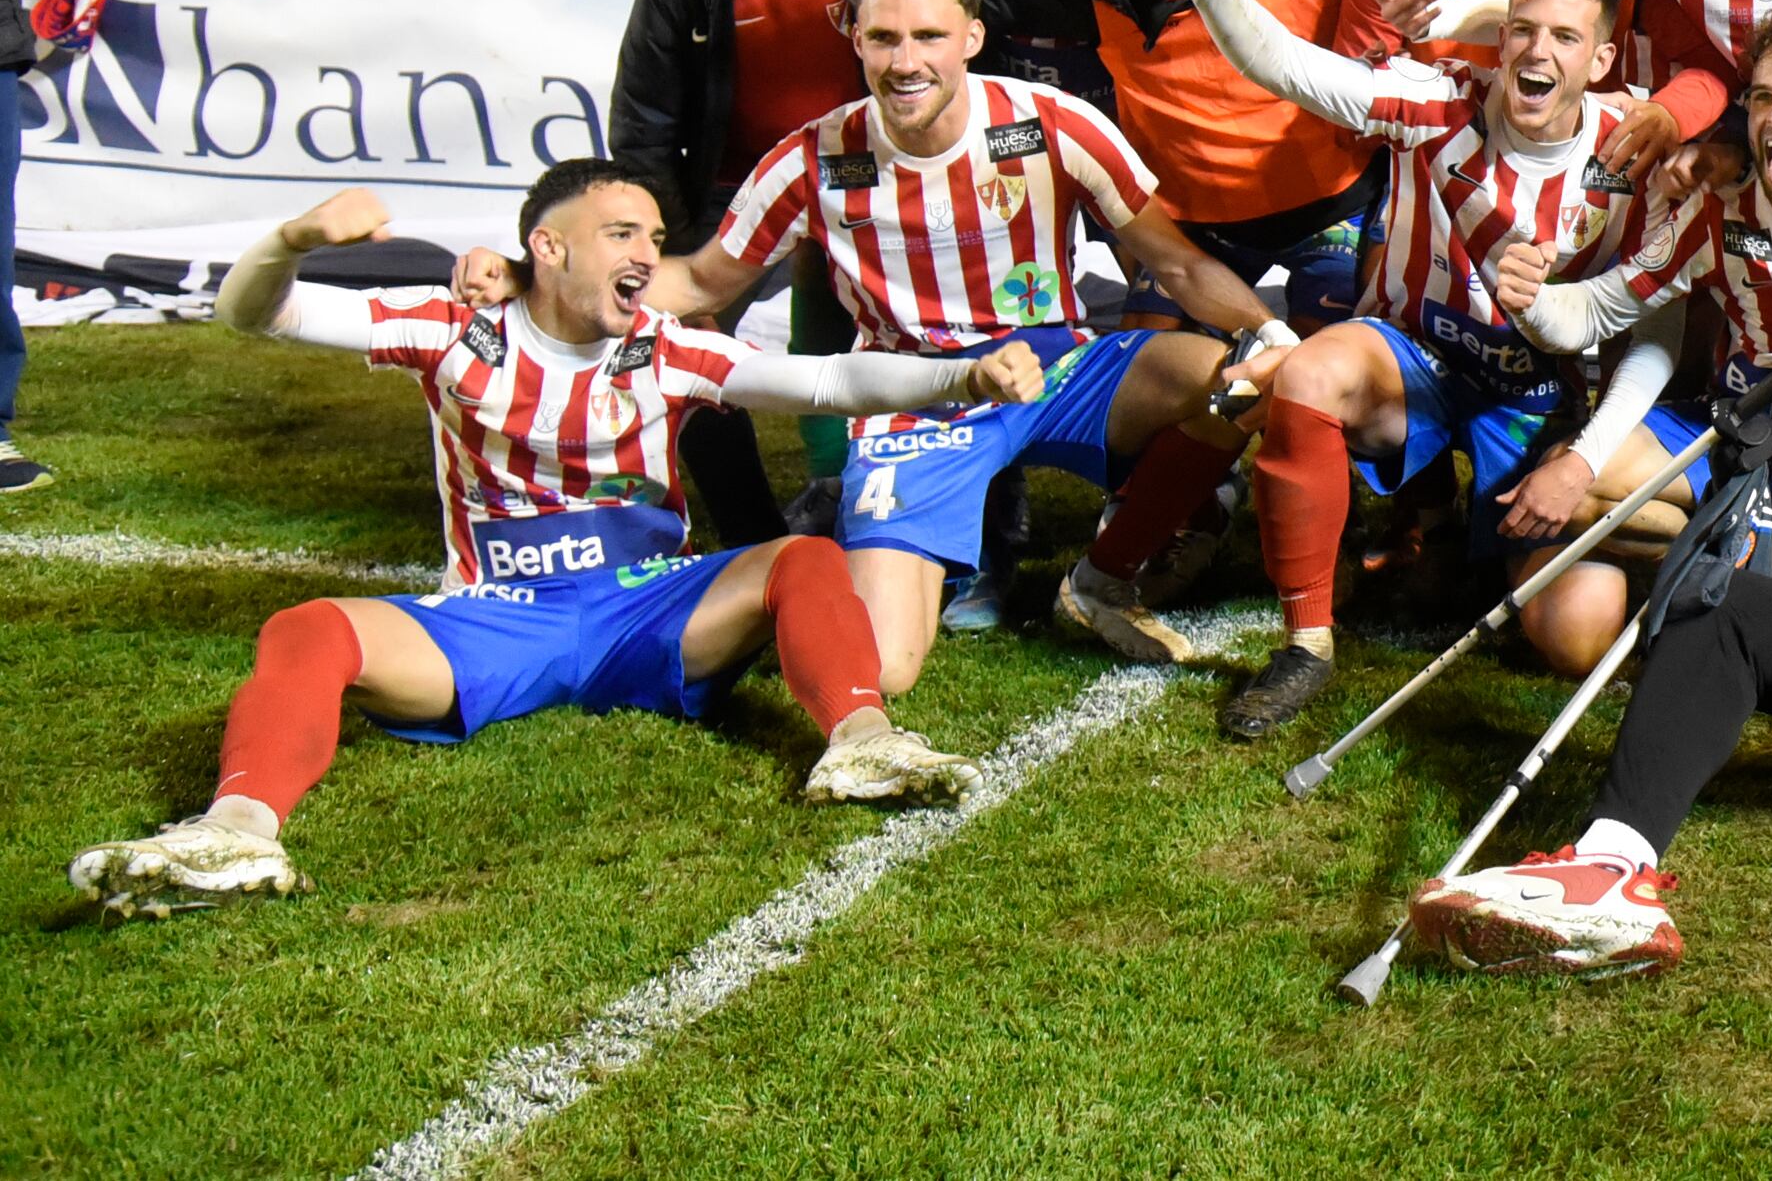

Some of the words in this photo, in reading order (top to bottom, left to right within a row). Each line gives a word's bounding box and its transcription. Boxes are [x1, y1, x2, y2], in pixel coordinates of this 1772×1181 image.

[988, 130, 1043, 151] Huesca
[820, 163, 876, 178] Huesca
[1724, 231, 1771, 251] Huesca
[1433, 315, 1535, 375] Berta
[857, 425, 974, 459] Roacsa
[854, 465, 897, 521] 4
[486, 534, 606, 578] Berta
